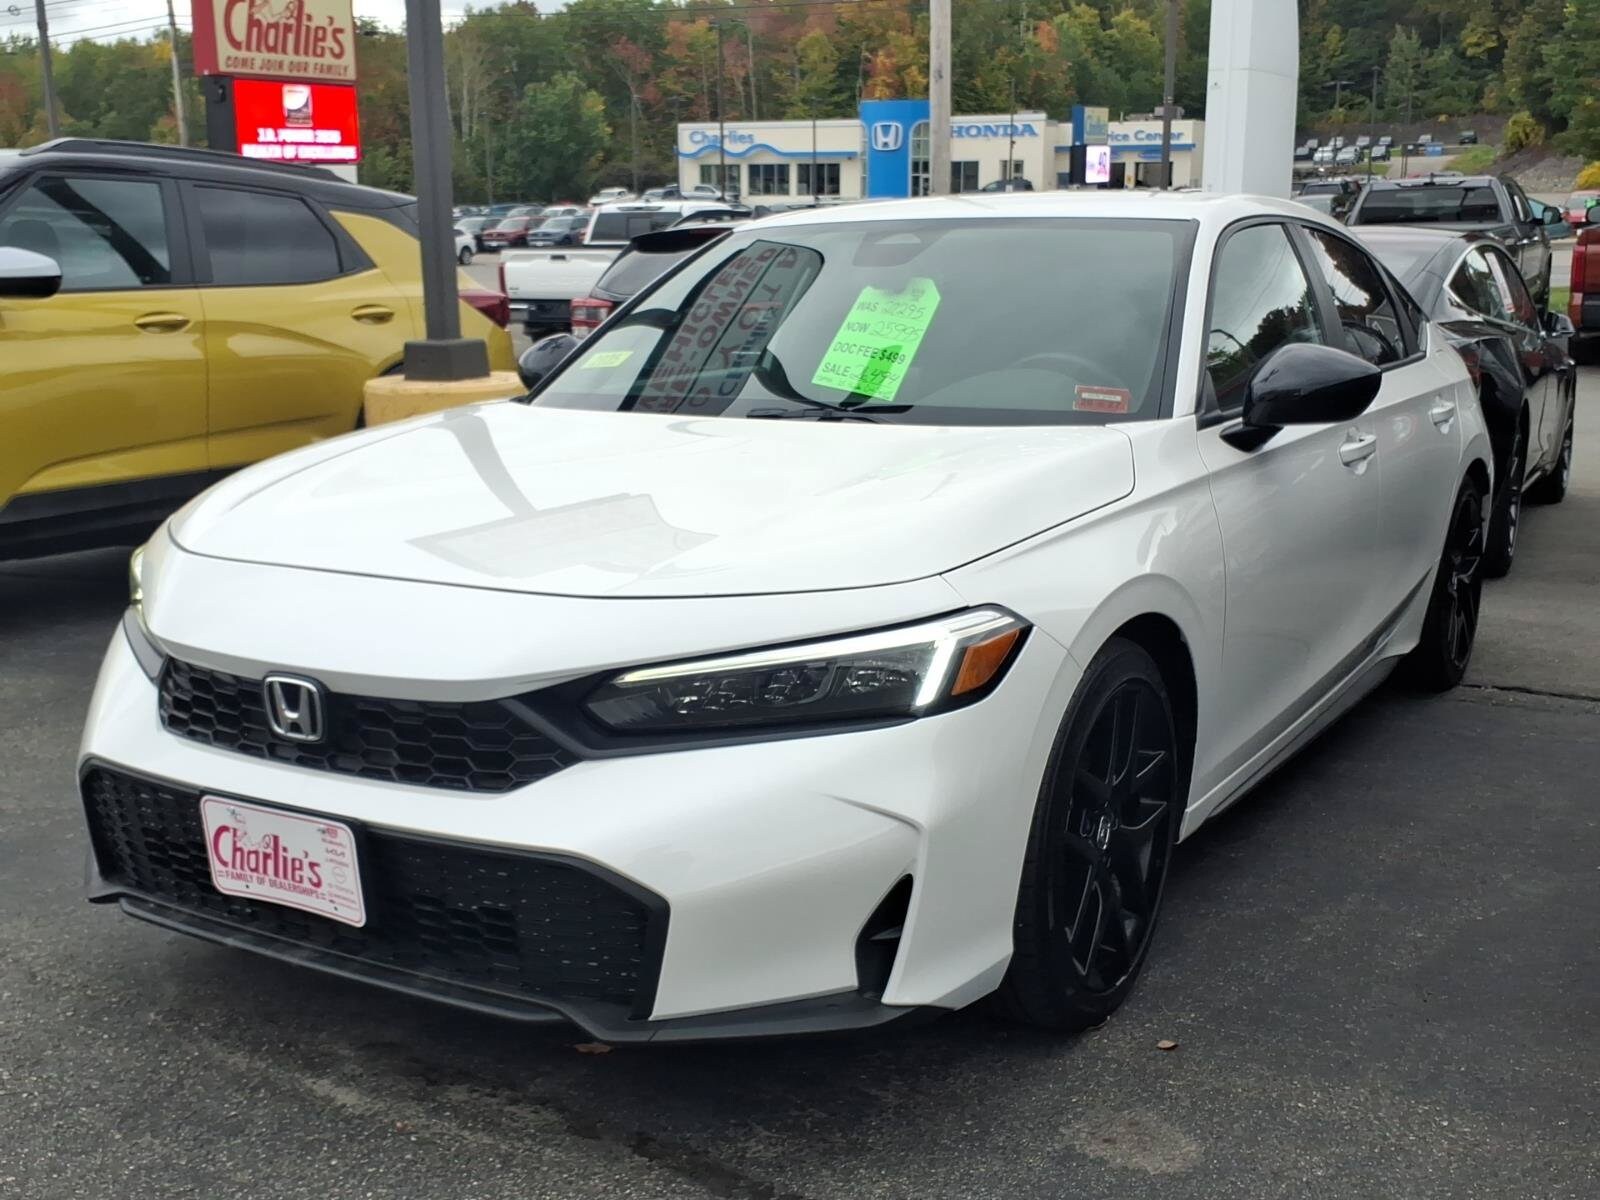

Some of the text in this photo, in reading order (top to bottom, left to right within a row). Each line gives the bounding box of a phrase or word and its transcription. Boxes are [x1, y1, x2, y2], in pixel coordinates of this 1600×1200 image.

[225, 55, 350, 77] COME JOIN OUR FAMILY
[949, 123, 1038, 138] HONDA
[846, 321, 870, 334] NOW
[833, 342, 906, 365] DOC FEE $499
[822, 362, 851, 377] SALE
[213, 824, 322, 889] Charlie's
[224, 870, 254, 884] FAMILY
[256, 875, 268, 887] OF
[268, 878, 320, 899] DEALERSHIPS
